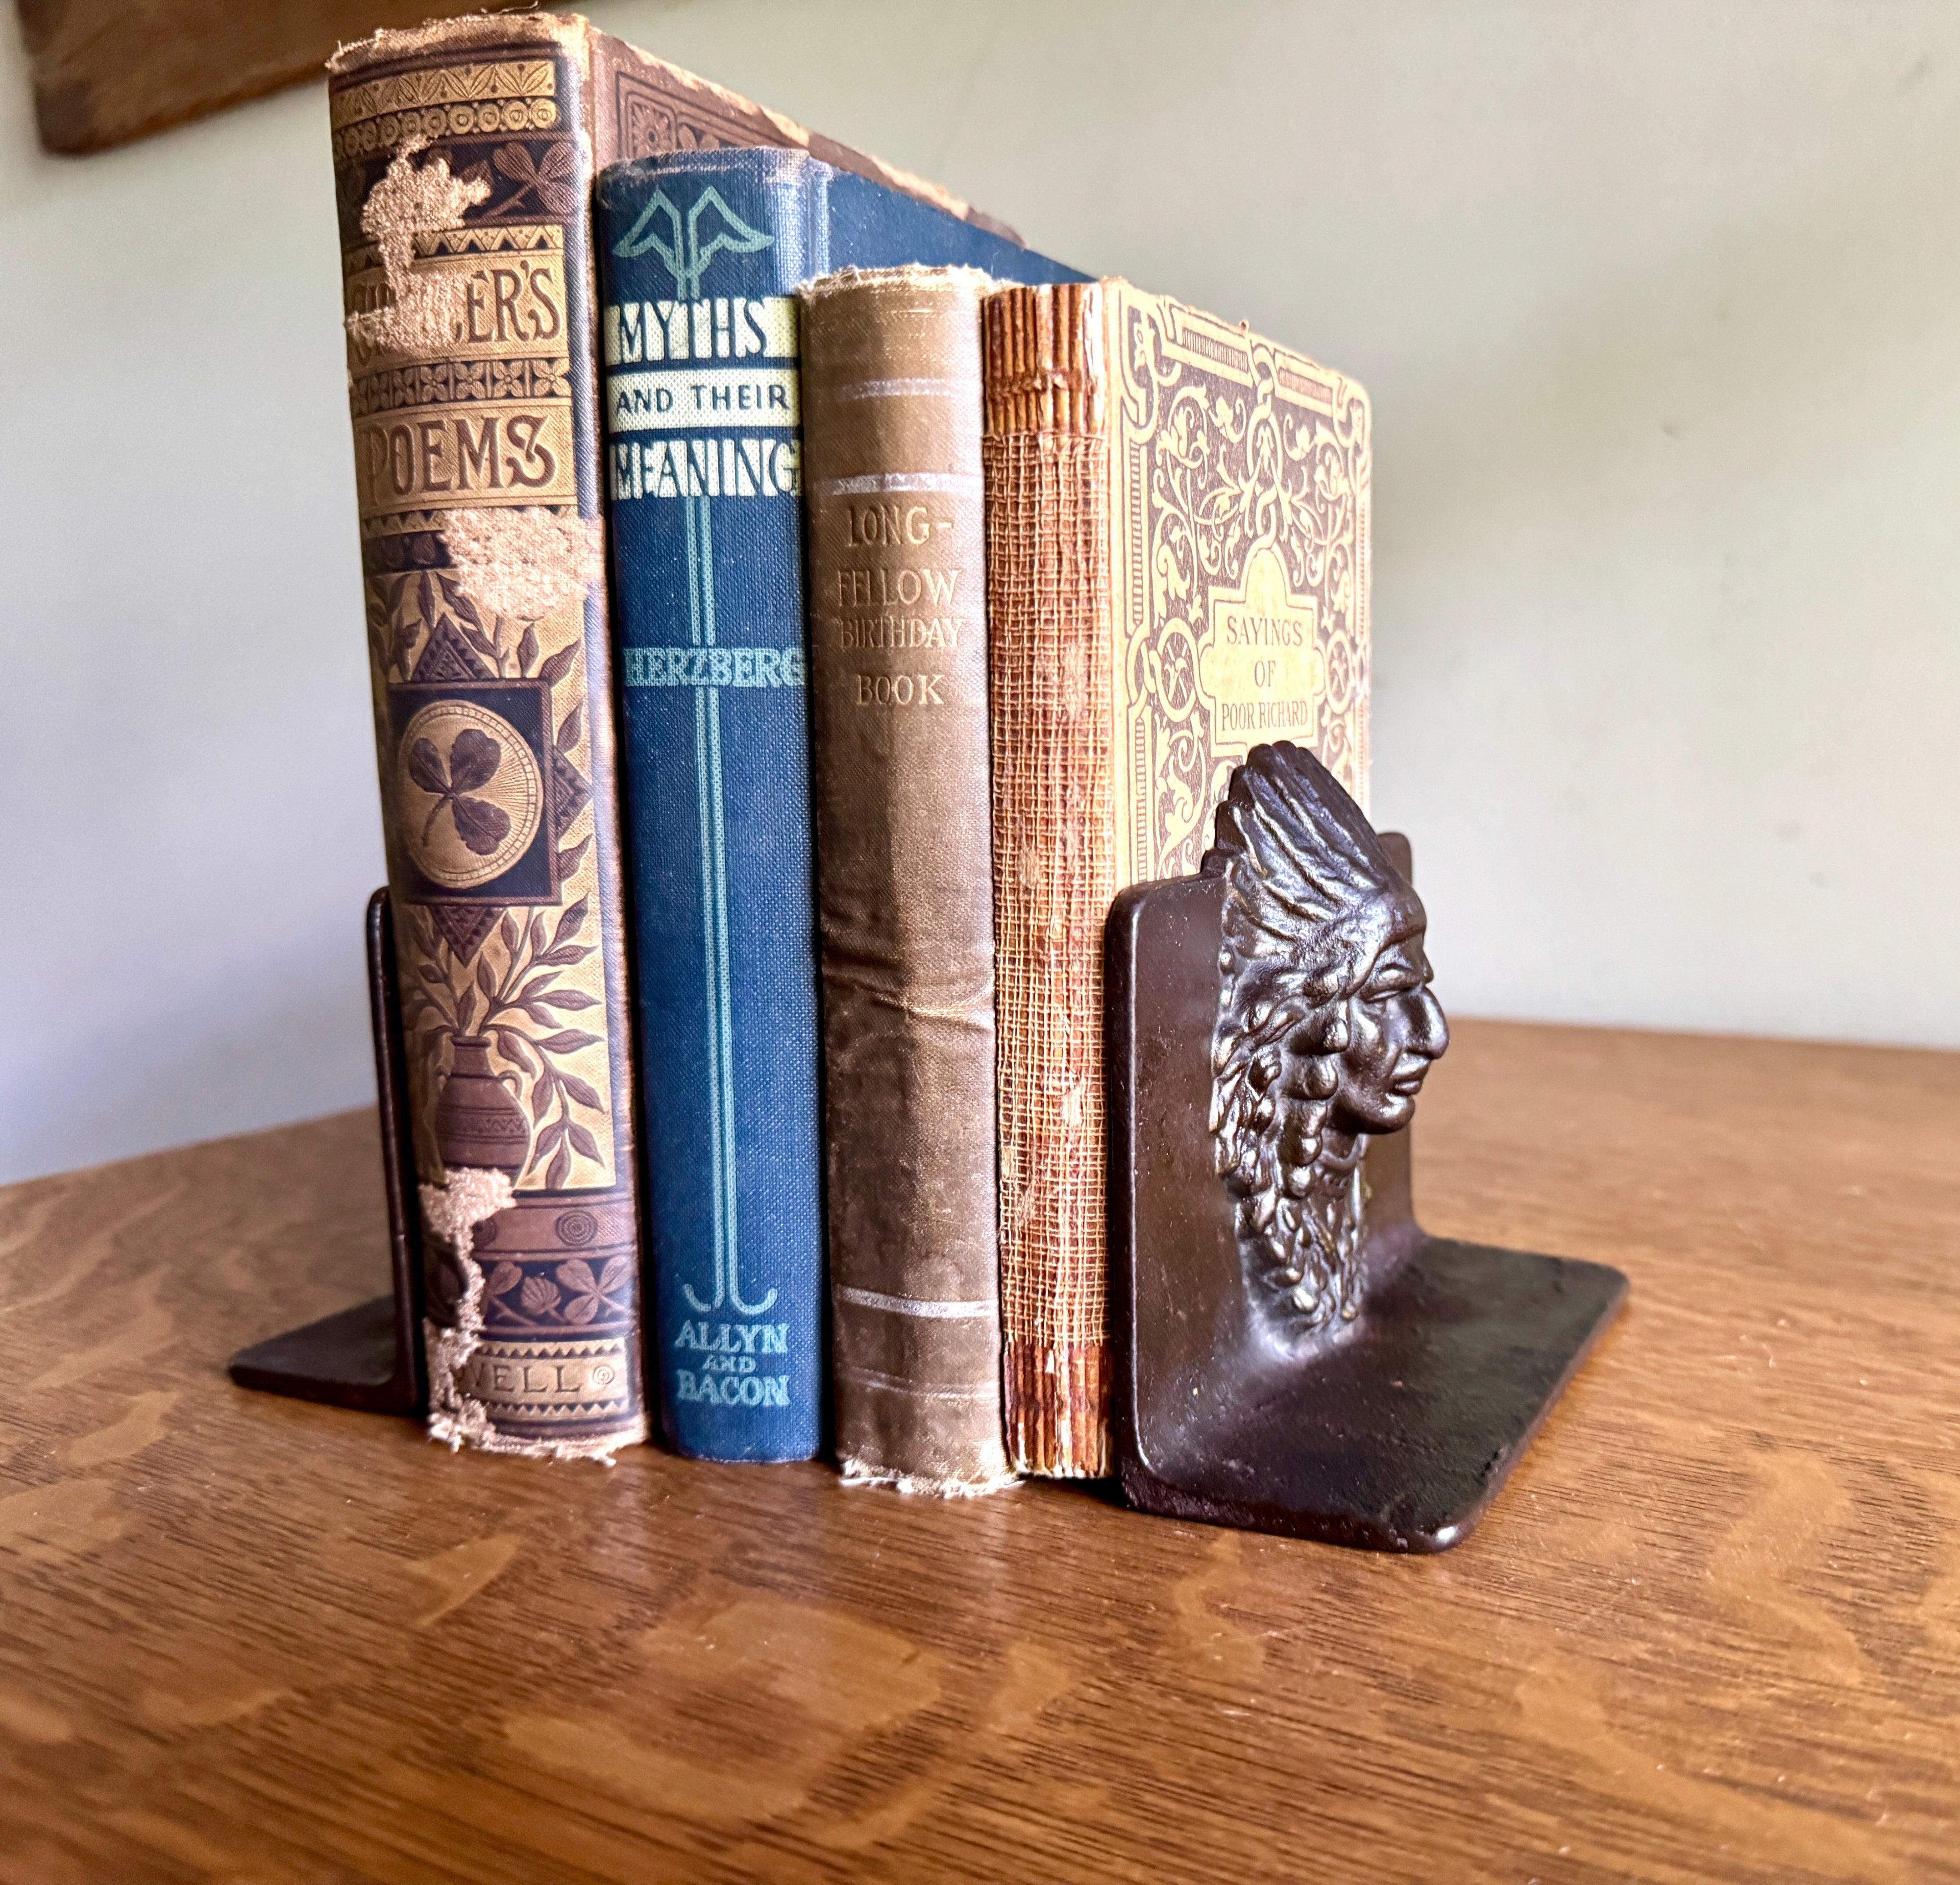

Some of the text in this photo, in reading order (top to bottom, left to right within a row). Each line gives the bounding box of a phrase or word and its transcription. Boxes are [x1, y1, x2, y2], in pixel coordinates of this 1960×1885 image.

[618, 298, 768, 363] MYTHS
[616, 384, 791, 414] AND THEIR
[359, 414, 557, 505] POEMS
[614, 438, 802, 499] MEANING
[846, 504, 952, 547] LONG-
[837, 568, 962, 607] FELLOW
[838, 615, 966, 651] BIRTHDAY
[1227, 616, 1303, 647] SAYINGS
[623, 647, 806, 688] HERZBERG
[1254, 660, 1276, 688] OF
[856, 674, 945, 705] BOOK
[1221, 700, 1308, 731] POOR RICHARD
[674, 1319, 790, 1354] ALLYN
[702, 1354, 756, 1373] AND
[676, 1368, 791, 1407] BACON
